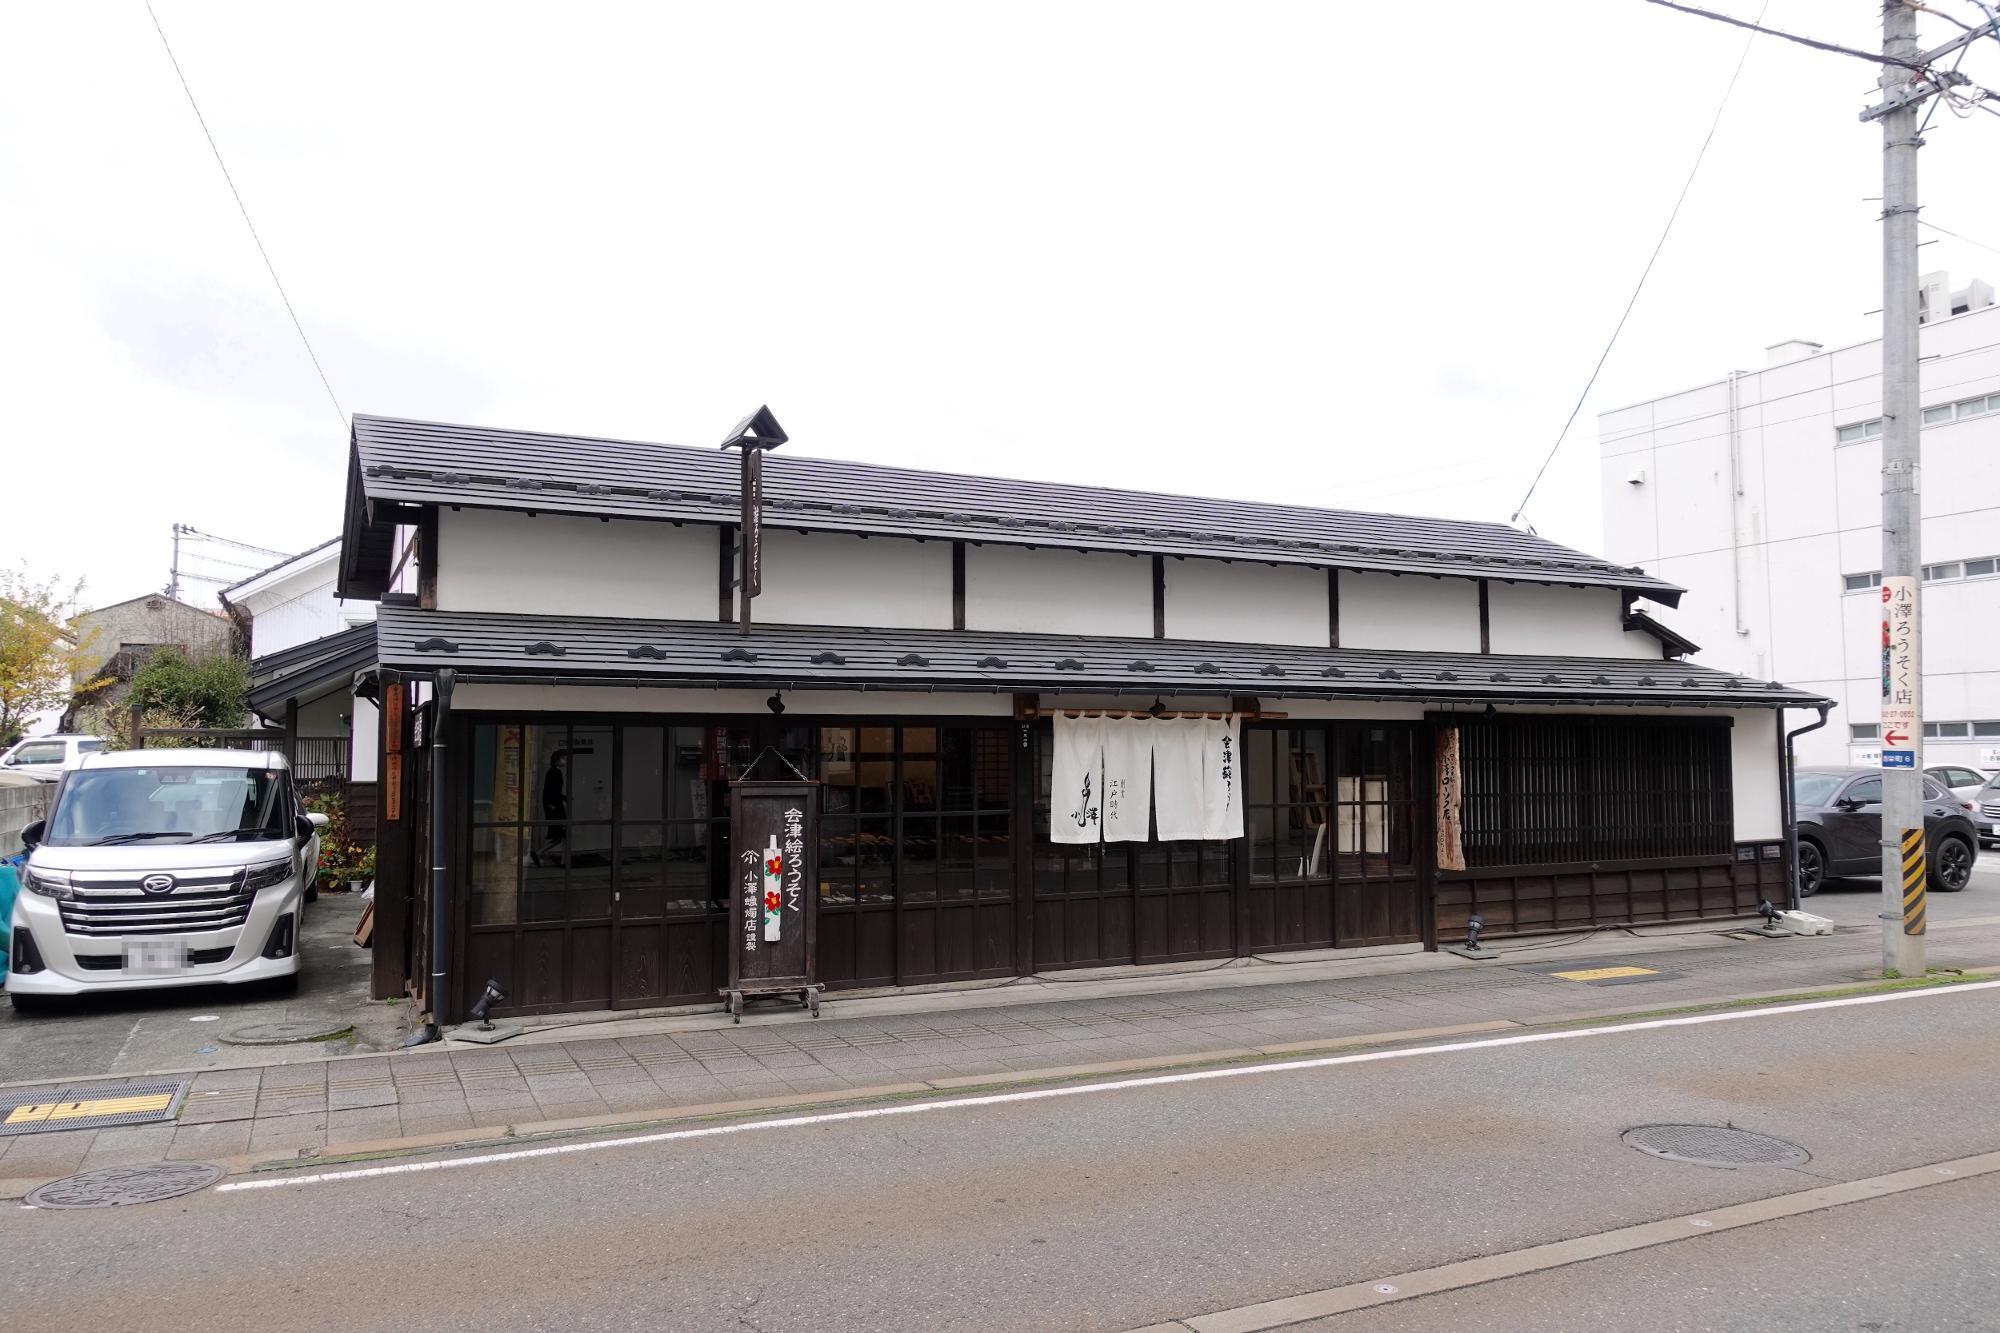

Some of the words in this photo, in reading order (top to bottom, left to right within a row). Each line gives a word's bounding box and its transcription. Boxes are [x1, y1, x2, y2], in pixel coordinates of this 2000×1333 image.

[1895, 585, 1912, 705] 小澤ろうそく店
[784, 807, 804, 912] 会津絵ろうそく
